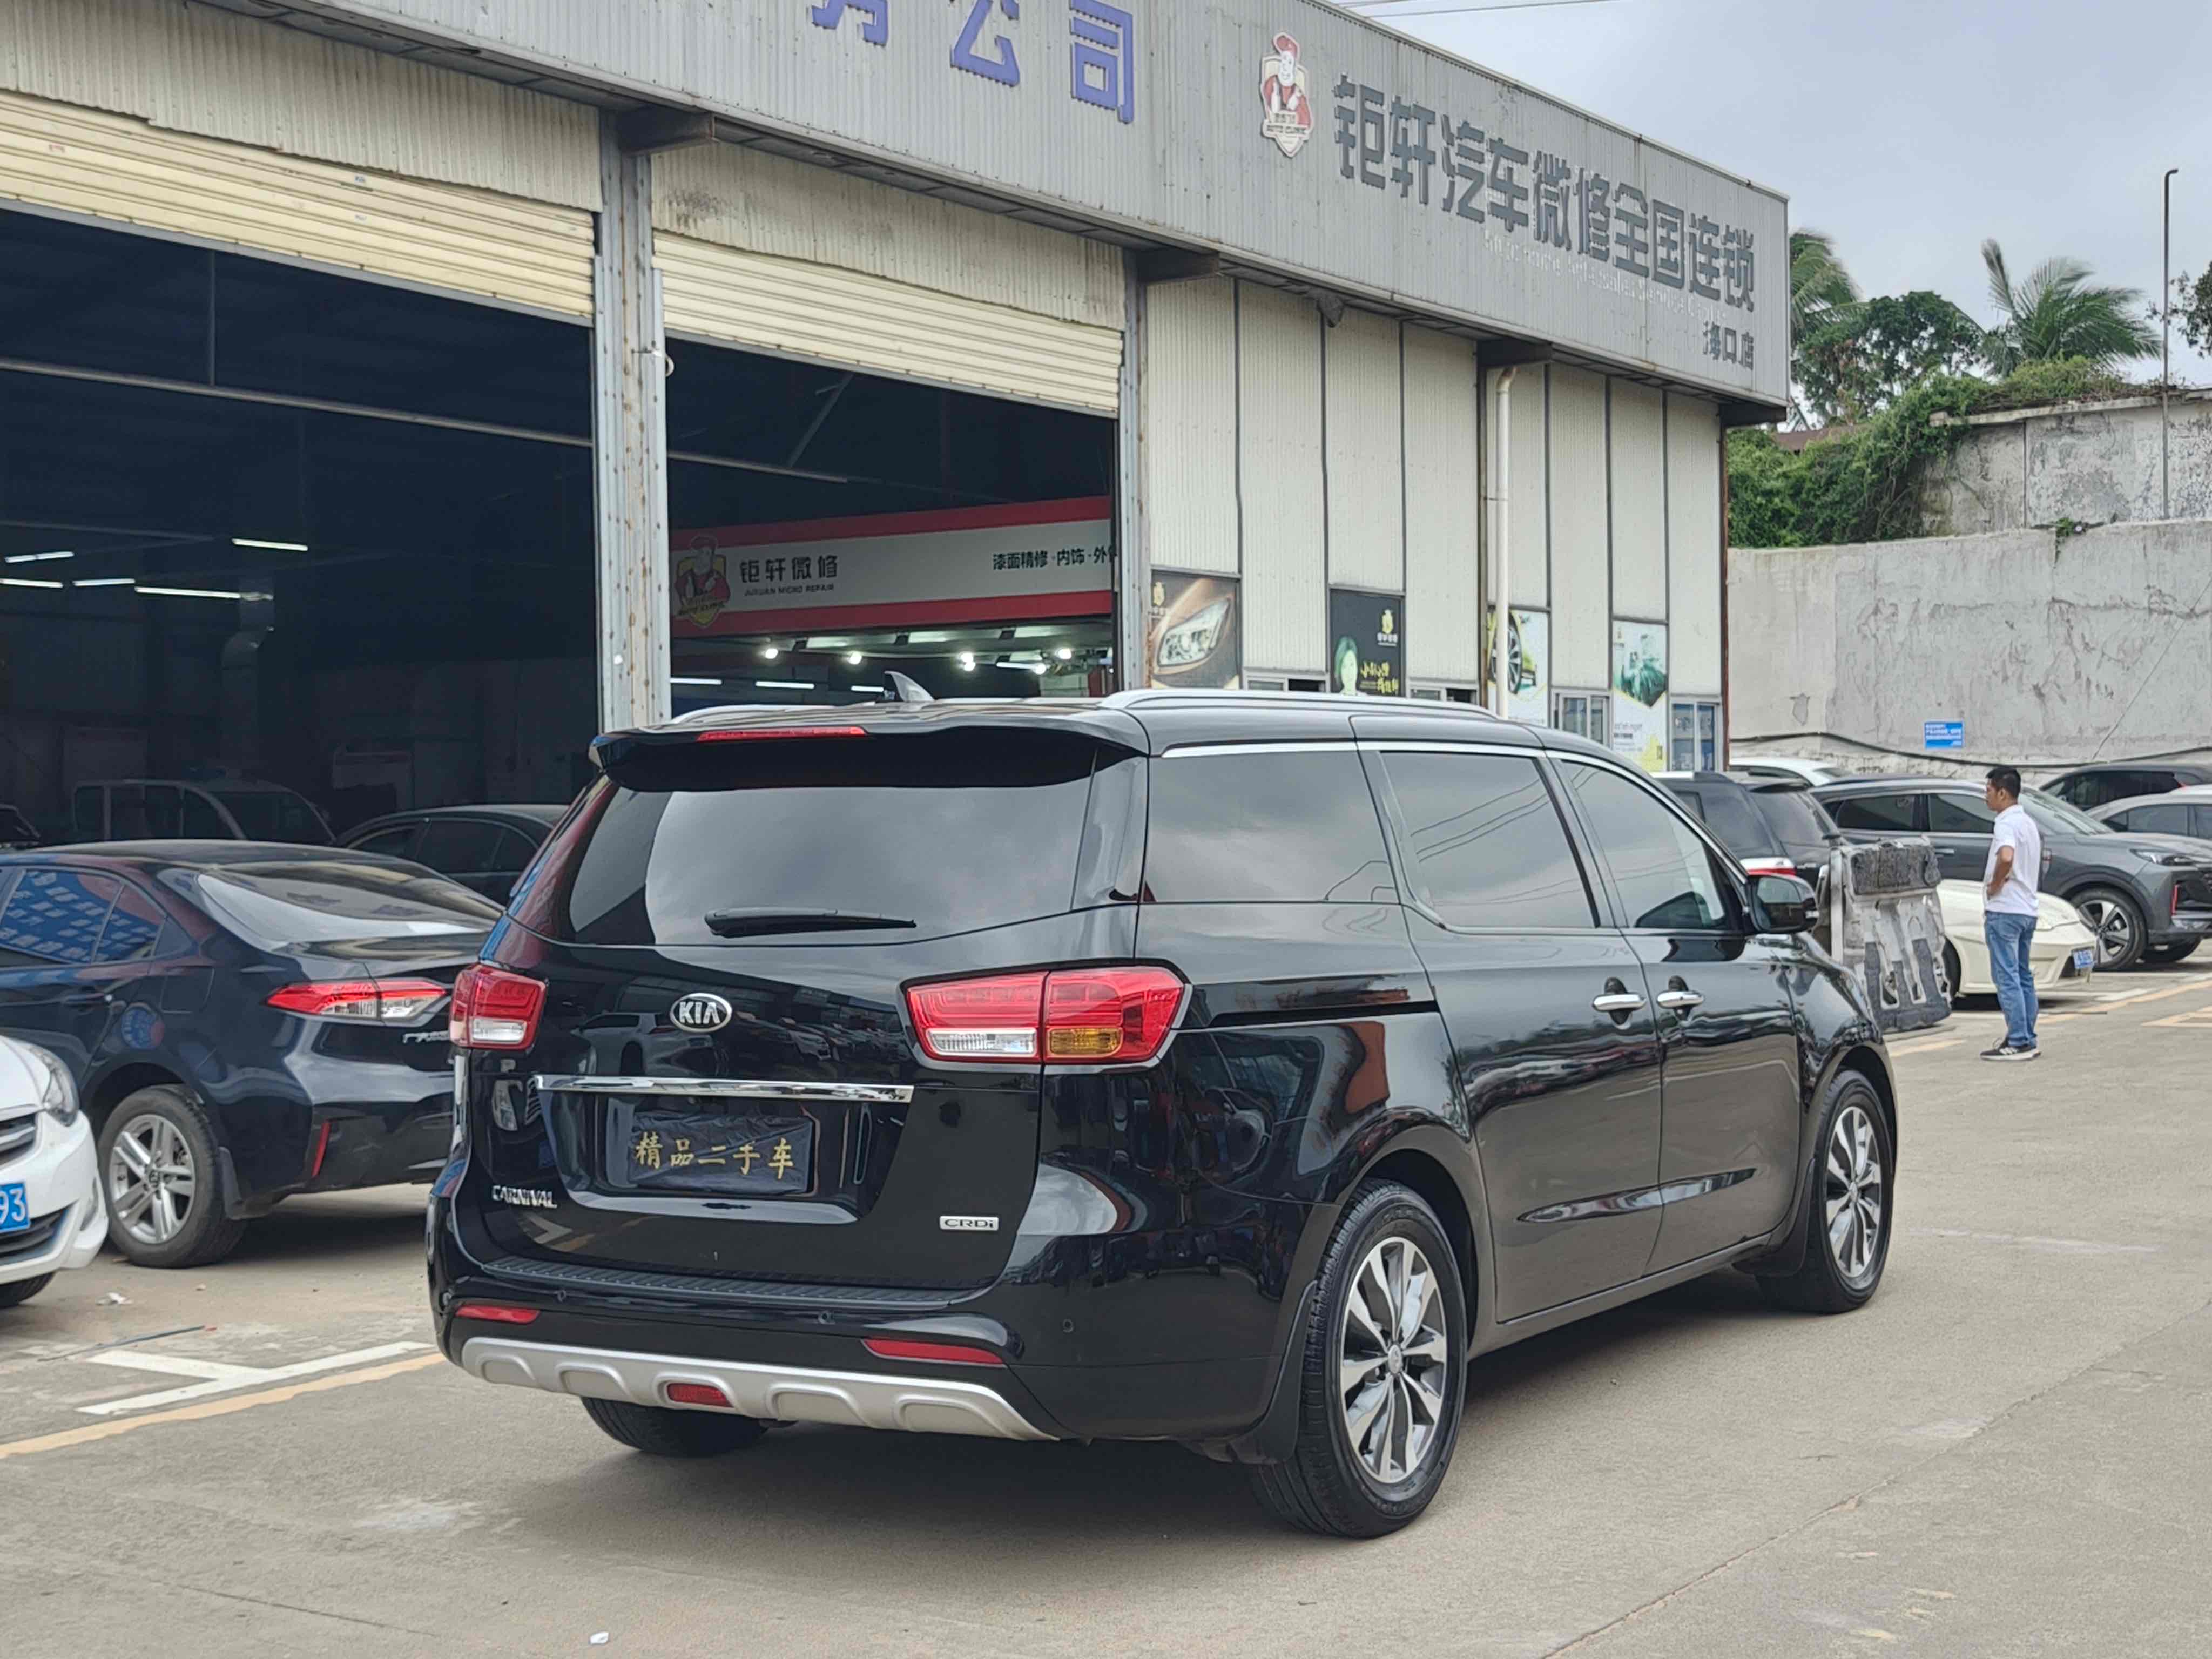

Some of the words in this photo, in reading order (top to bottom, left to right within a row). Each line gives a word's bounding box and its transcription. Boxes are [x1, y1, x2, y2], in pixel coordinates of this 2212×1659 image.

[1332, 73, 1754, 312] 钜轩汽车微修全国连锁
[1702, 321, 1754, 370] 海口店
[739, 555, 838, 584] 钜轩微修
[679, 1001, 721, 1024] KIA
[635, 1131, 794, 1179] 精品二手车
[491, 1185, 558, 1209] CARNIVAL
[944, 1218, 994, 1229] CRDi
